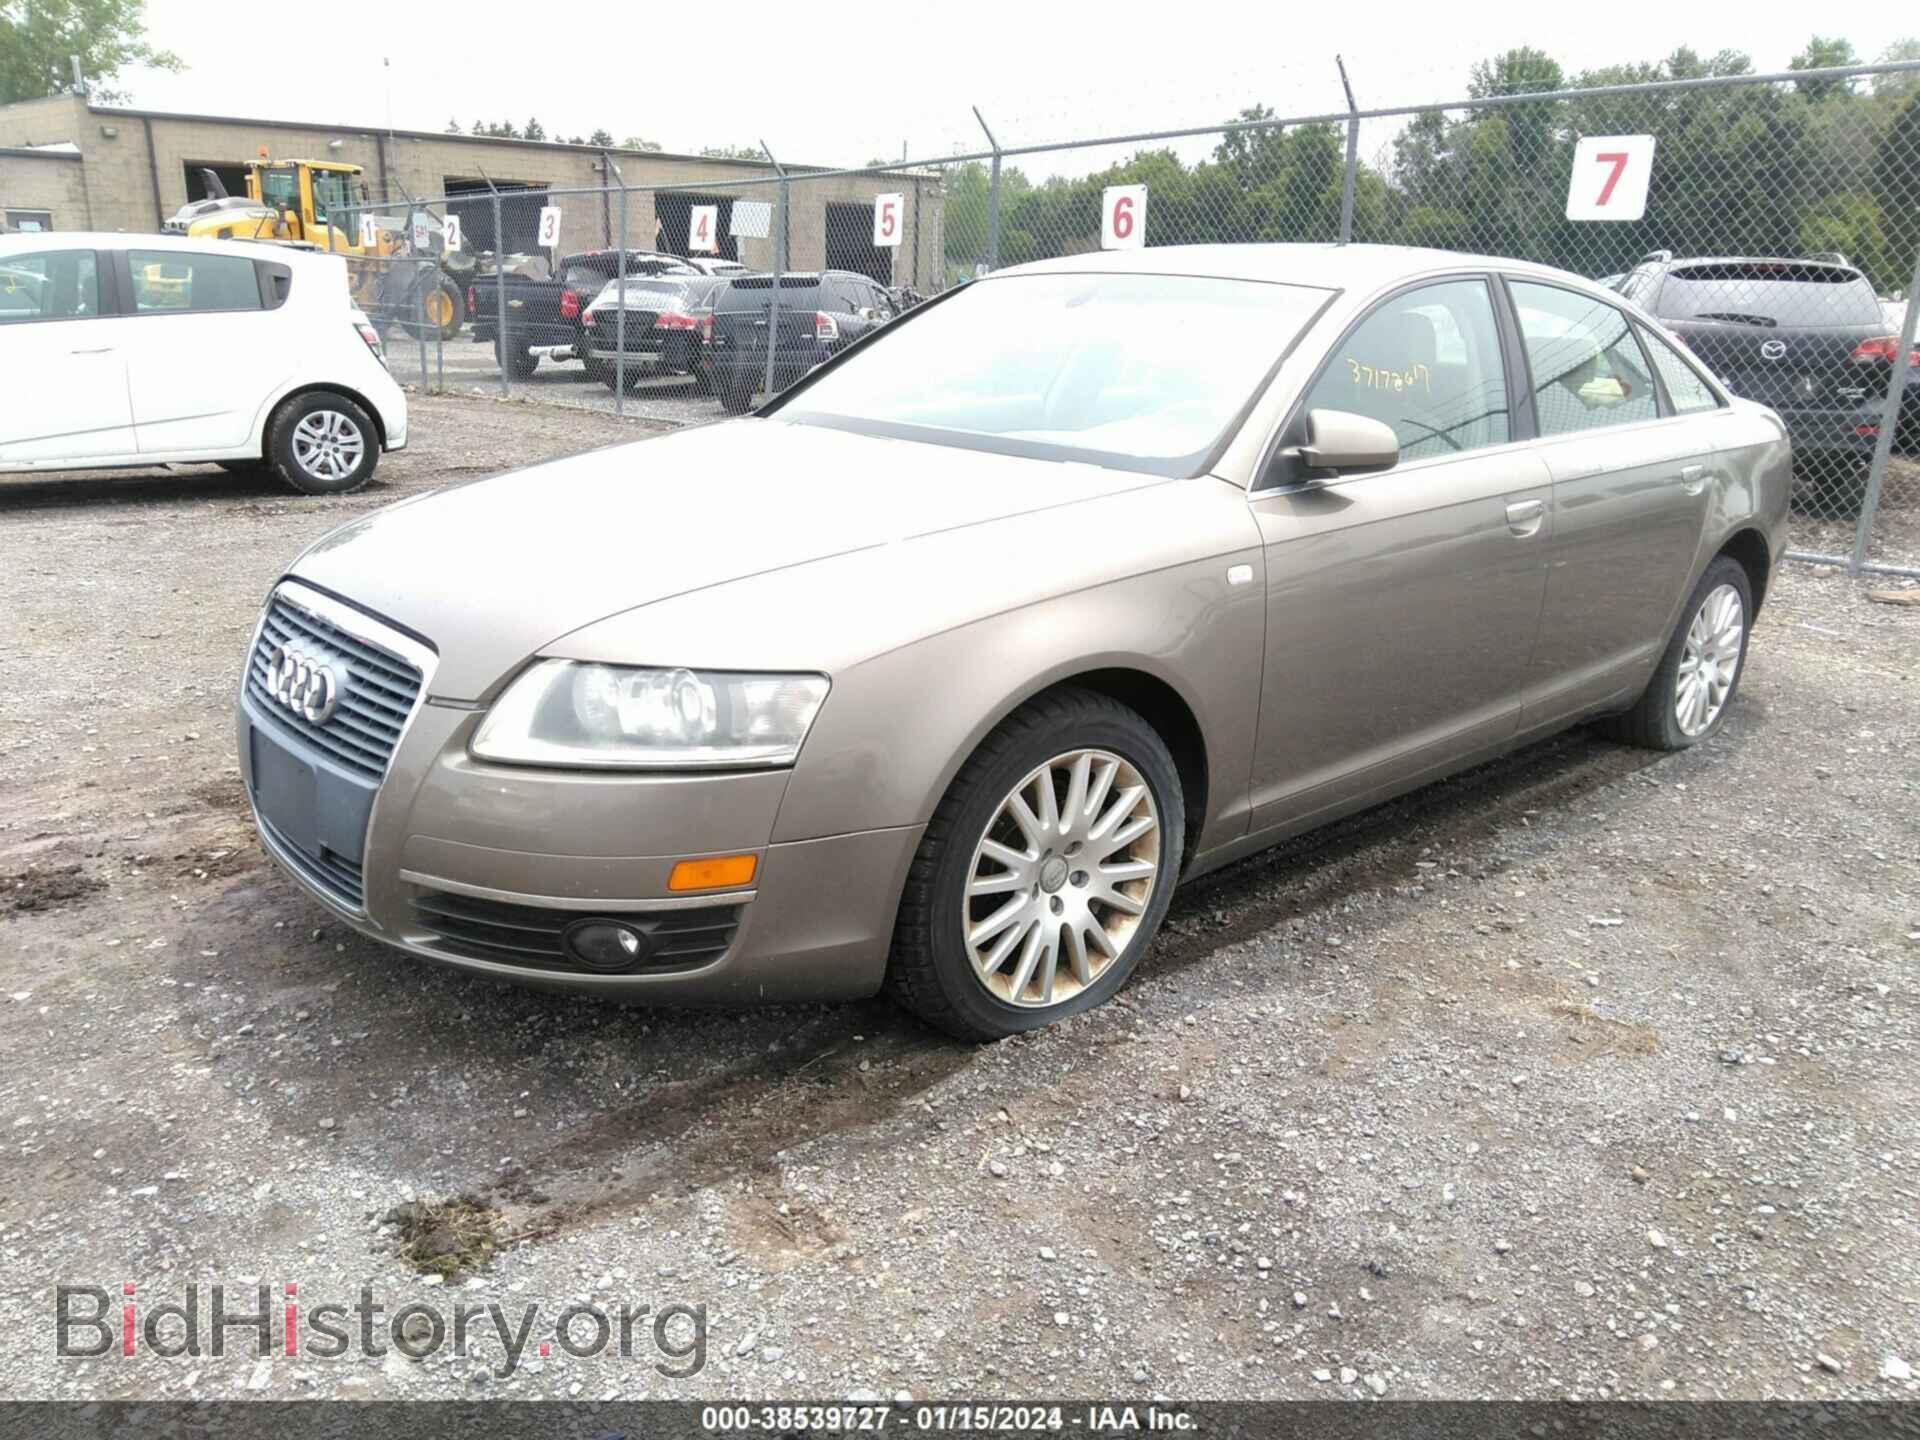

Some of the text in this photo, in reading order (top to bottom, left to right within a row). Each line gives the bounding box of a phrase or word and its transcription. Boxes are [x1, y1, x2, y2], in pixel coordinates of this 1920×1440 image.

[1596, 152, 1629, 206] 7
[366, 221, 372, 241] 1
[545, 215, 554, 240] 3
[696, 215, 708, 242] 4
[882, 203, 896, 237] 5
[1112, 197, 1134, 239] 6
[447, 222, 456, 245] 2
